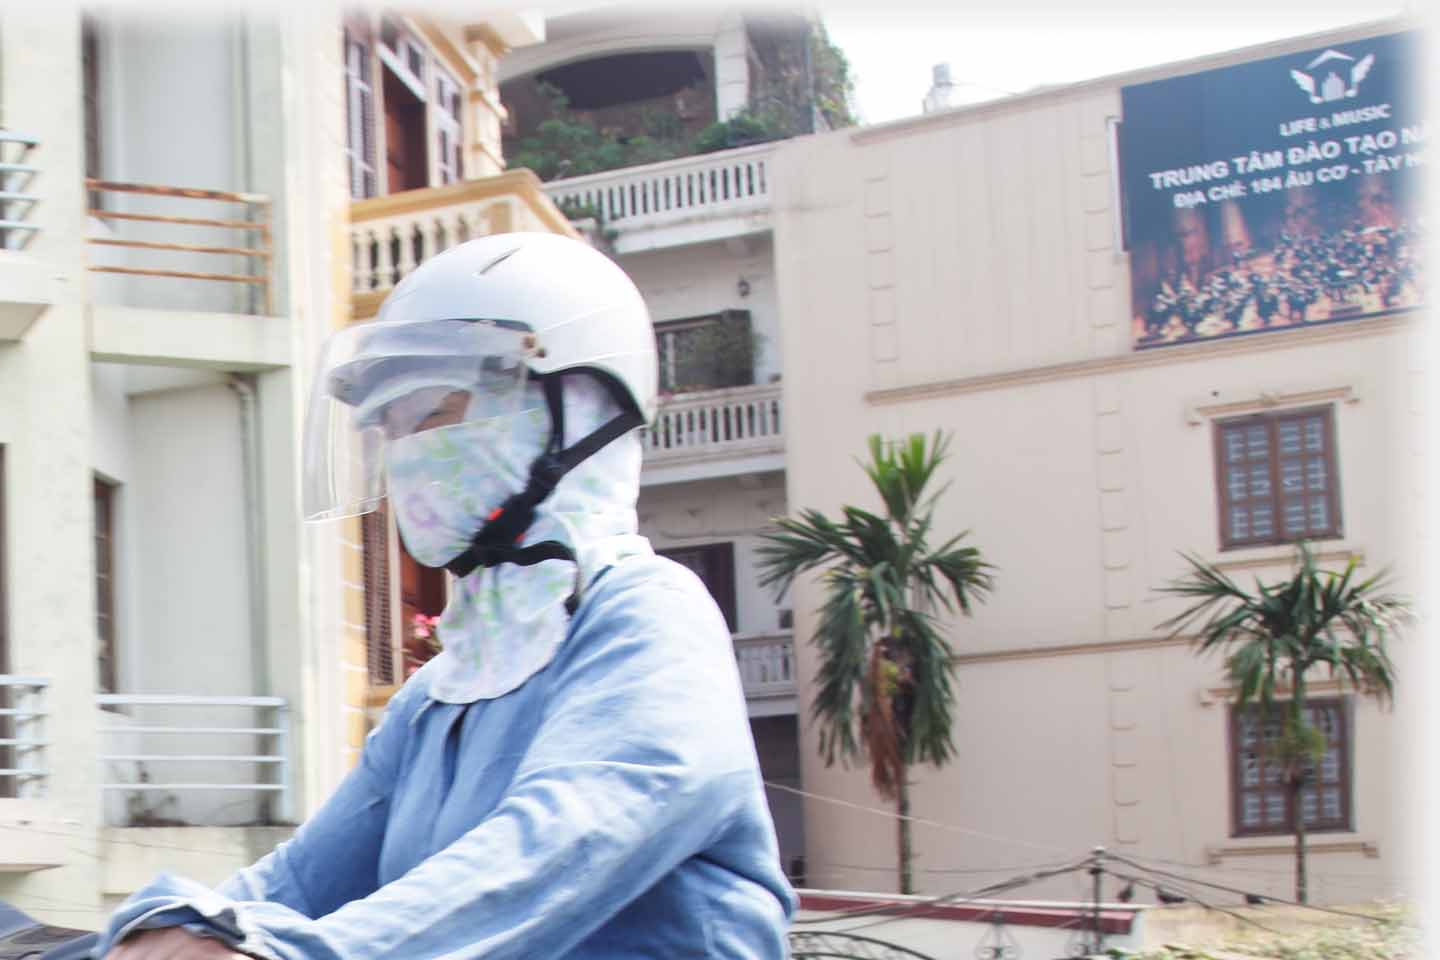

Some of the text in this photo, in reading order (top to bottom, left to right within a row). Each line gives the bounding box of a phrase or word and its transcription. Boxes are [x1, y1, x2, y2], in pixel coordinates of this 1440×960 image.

[1279, 103, 1392, 136] LIFE & MUSIC
[1149, 161, 1229, 190] TRUNG
[1232, 150, 1284, 174] TÂM
[1287, 140, 1341, 165] ĐÀO
[1344, 130, 1397, 156] TẠO
